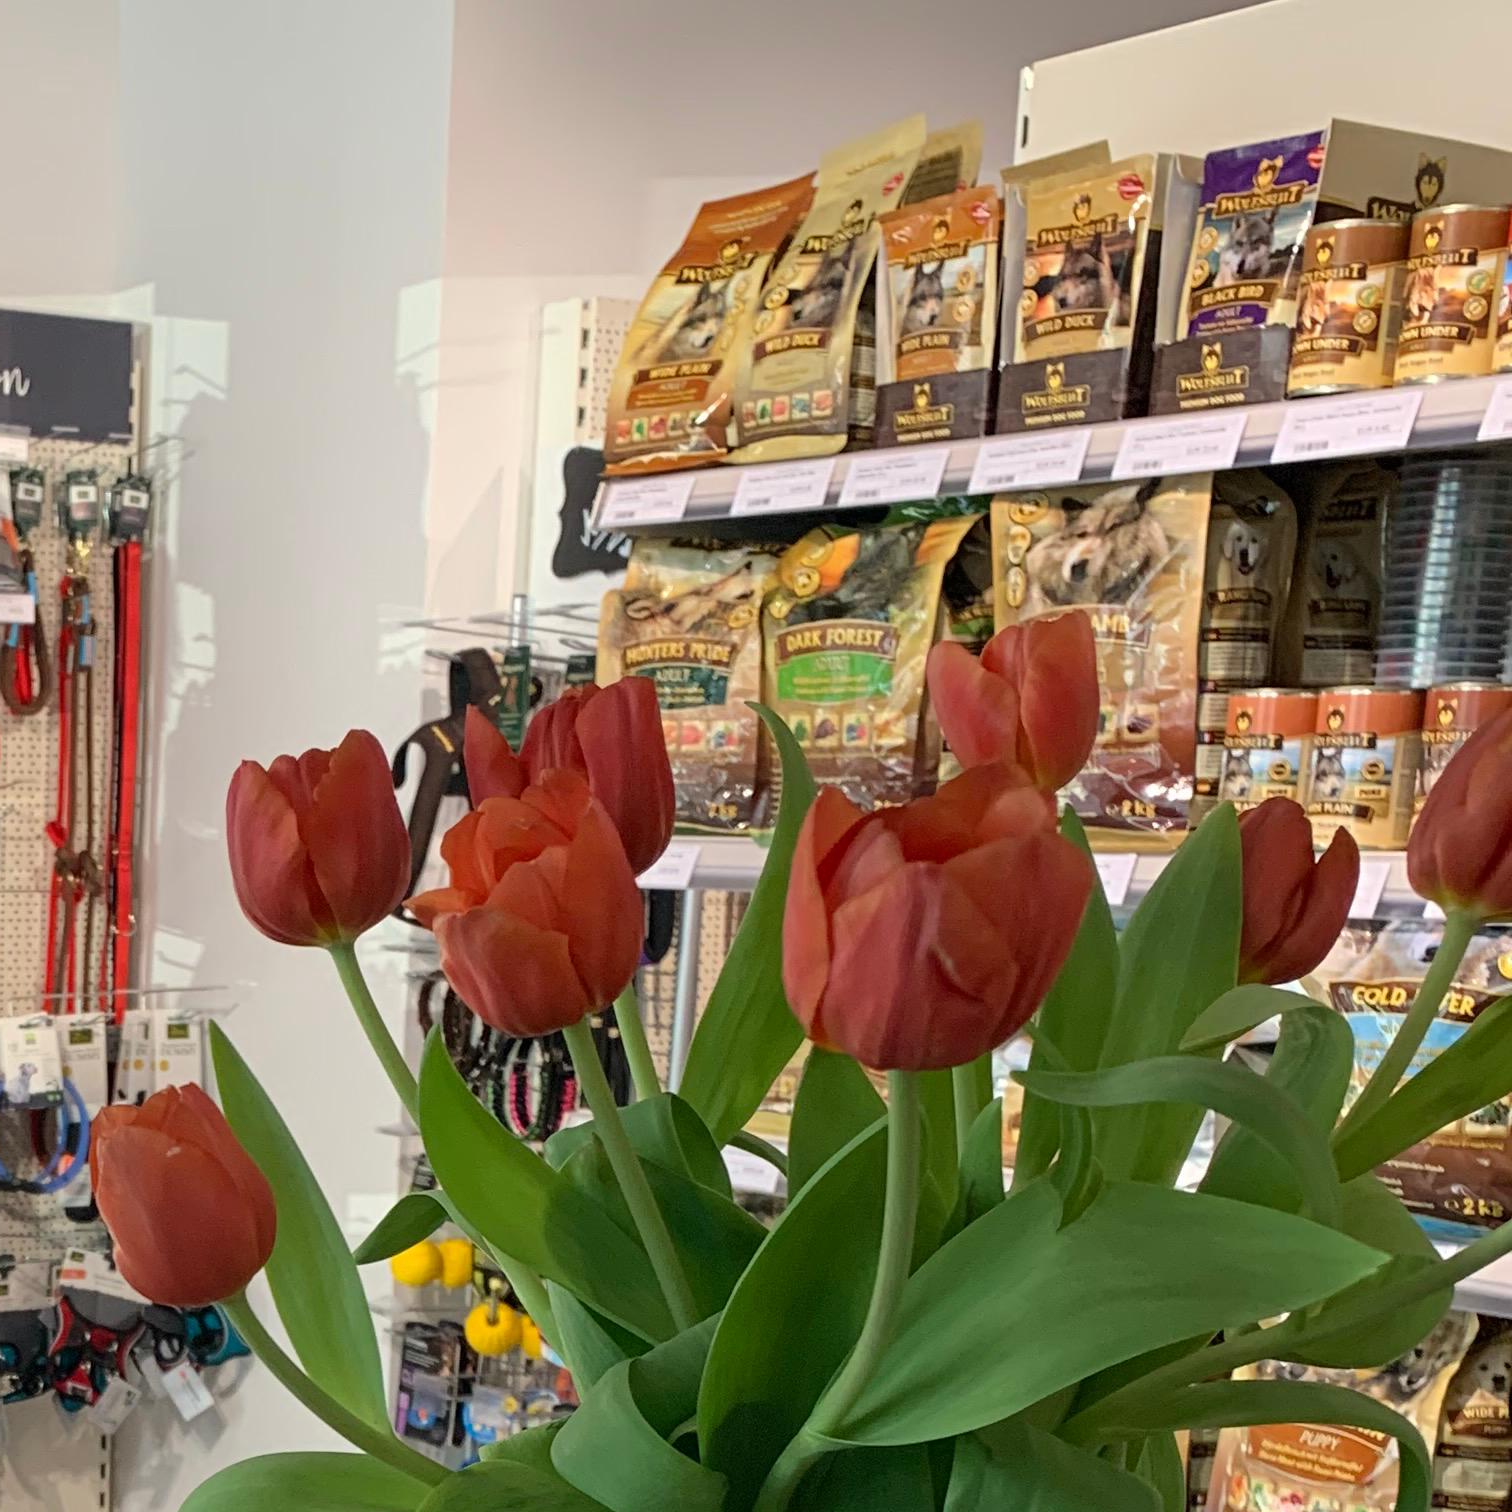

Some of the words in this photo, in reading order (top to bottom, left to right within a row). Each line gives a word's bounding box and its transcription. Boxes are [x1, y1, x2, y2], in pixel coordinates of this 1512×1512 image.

[1201, 288, 1235, 305] BLACK
[1036, 319, 1062, 335] WILD
[1065, 315, 1095, 329] DUCK
[1420, 326, 1459, 339] UNDER
[1313, 338, 1350, 350] UNDER
[1091, 614, 1130, 634] AMB
[786, 632, 821, 652] DARK
[825, 629, 884, 648] FOREST
[689, 640, 732, 662] PRIDE
[1351, 986, 1407, 1008] COLD
[1299, 1429, 1342, 1451] PUPPY
